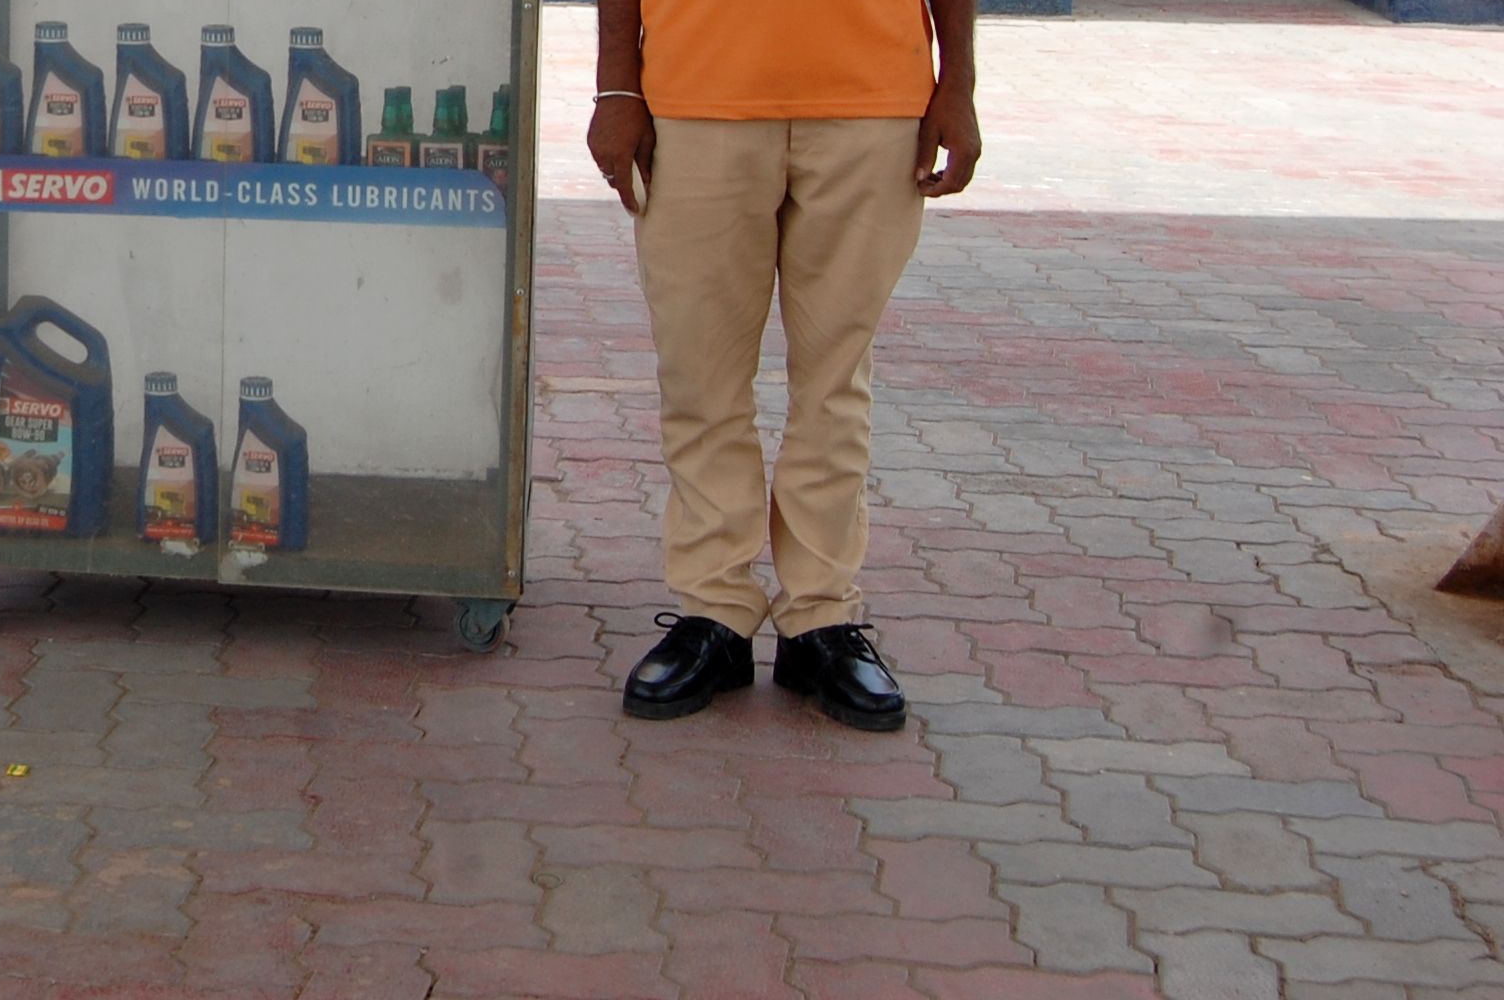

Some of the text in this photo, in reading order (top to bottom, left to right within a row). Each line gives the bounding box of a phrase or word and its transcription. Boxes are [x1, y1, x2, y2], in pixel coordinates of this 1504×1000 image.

[8, 172, 495, 213] SERVO WORLD-CLASS LUBRICANTS
[12, 400, 62, 417] SERVO
[27, 417, 53, 430] SUPER
